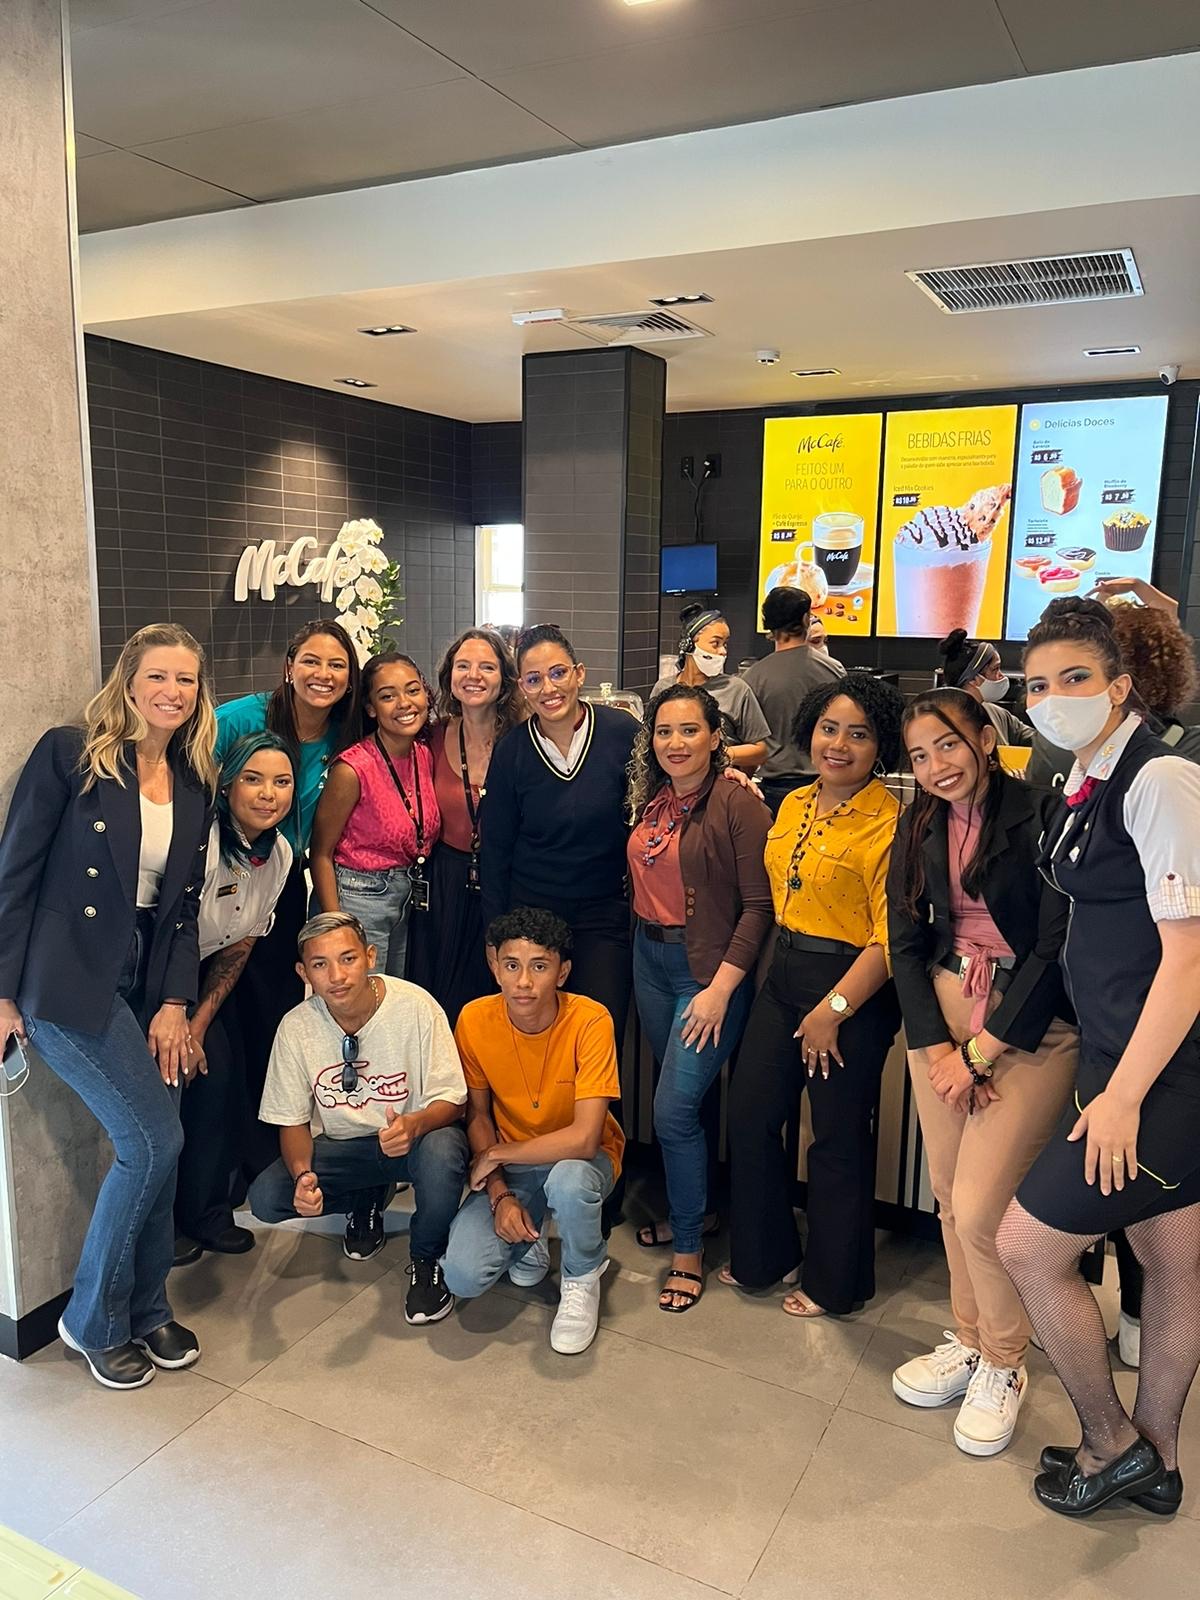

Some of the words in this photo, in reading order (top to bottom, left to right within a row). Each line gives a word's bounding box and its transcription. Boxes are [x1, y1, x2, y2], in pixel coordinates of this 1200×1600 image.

[1084, 417, 1115, 427] Doces
[798, 432, 843, 454] McCafé
[907, 431, 956, 449] BEBIDAS
[957, 429, 992, 447] FRIAS
[796, 462, 827, 475] FEITOS
[829, 462, 845, 475] UM
[785, 479, 808, 491] PARA
[810, 478, 818, 490] O
[819, 477, 853, 490] OUTRO
[234, 536, 351, 603] McCaf
